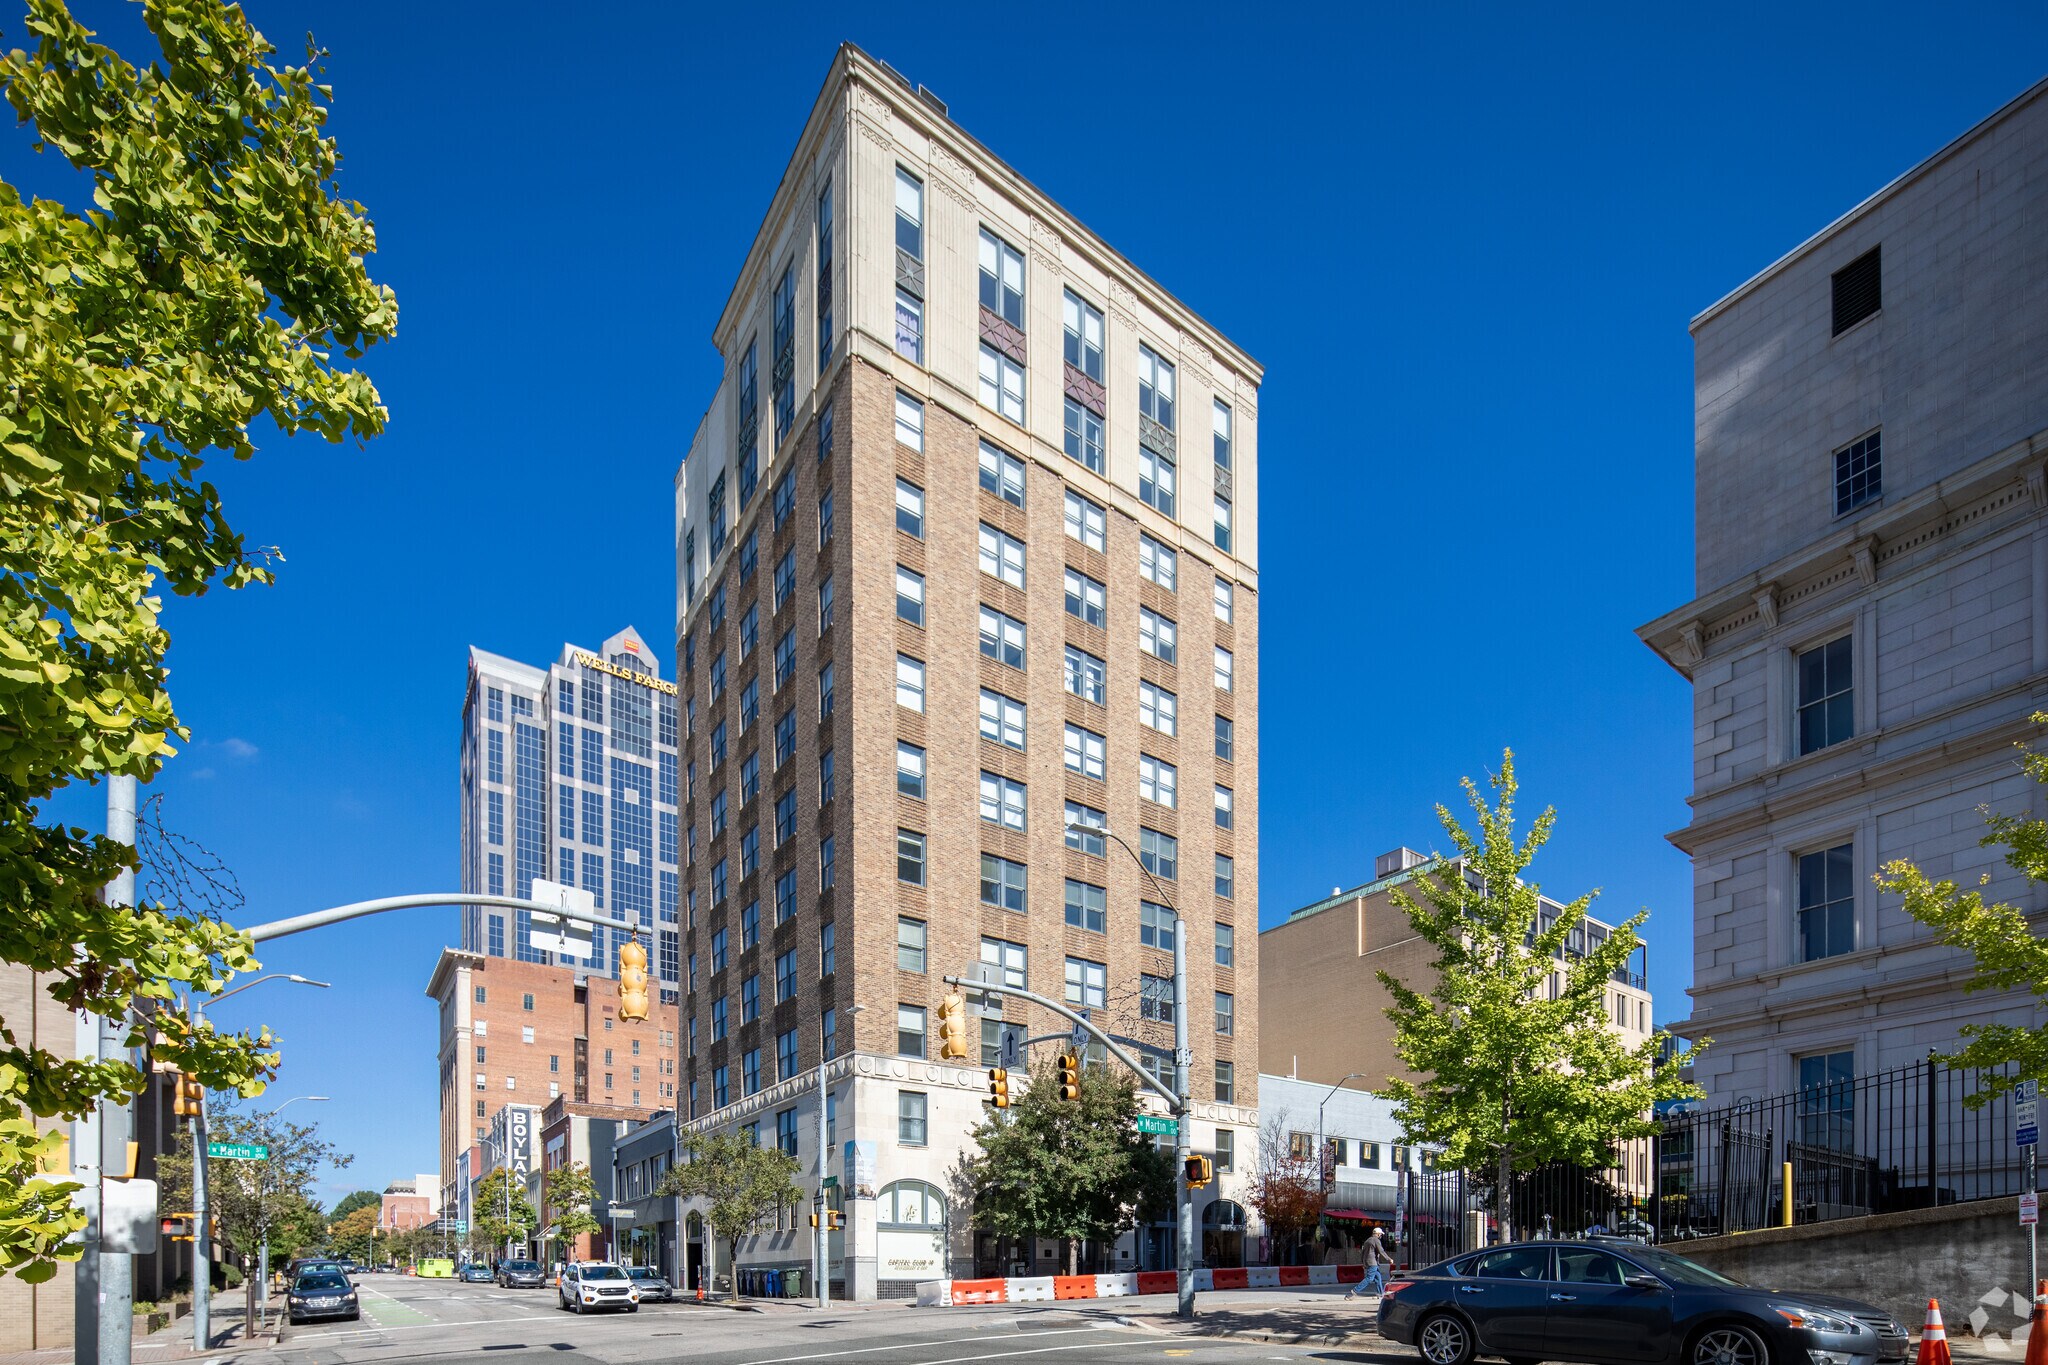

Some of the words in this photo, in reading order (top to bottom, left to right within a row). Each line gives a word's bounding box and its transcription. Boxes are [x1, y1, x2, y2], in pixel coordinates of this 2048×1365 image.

[575, 651, 632, 680] WELLS
[1074, 1033, 1087, 1045] ONLY
[1004, 1055, 1016, 1066] ONLY
[2016, 1086, 2023, 1103] 2
[1145, 1118, 1167, 1132] Martin
[220, 1146, 250, 1157] Martin
